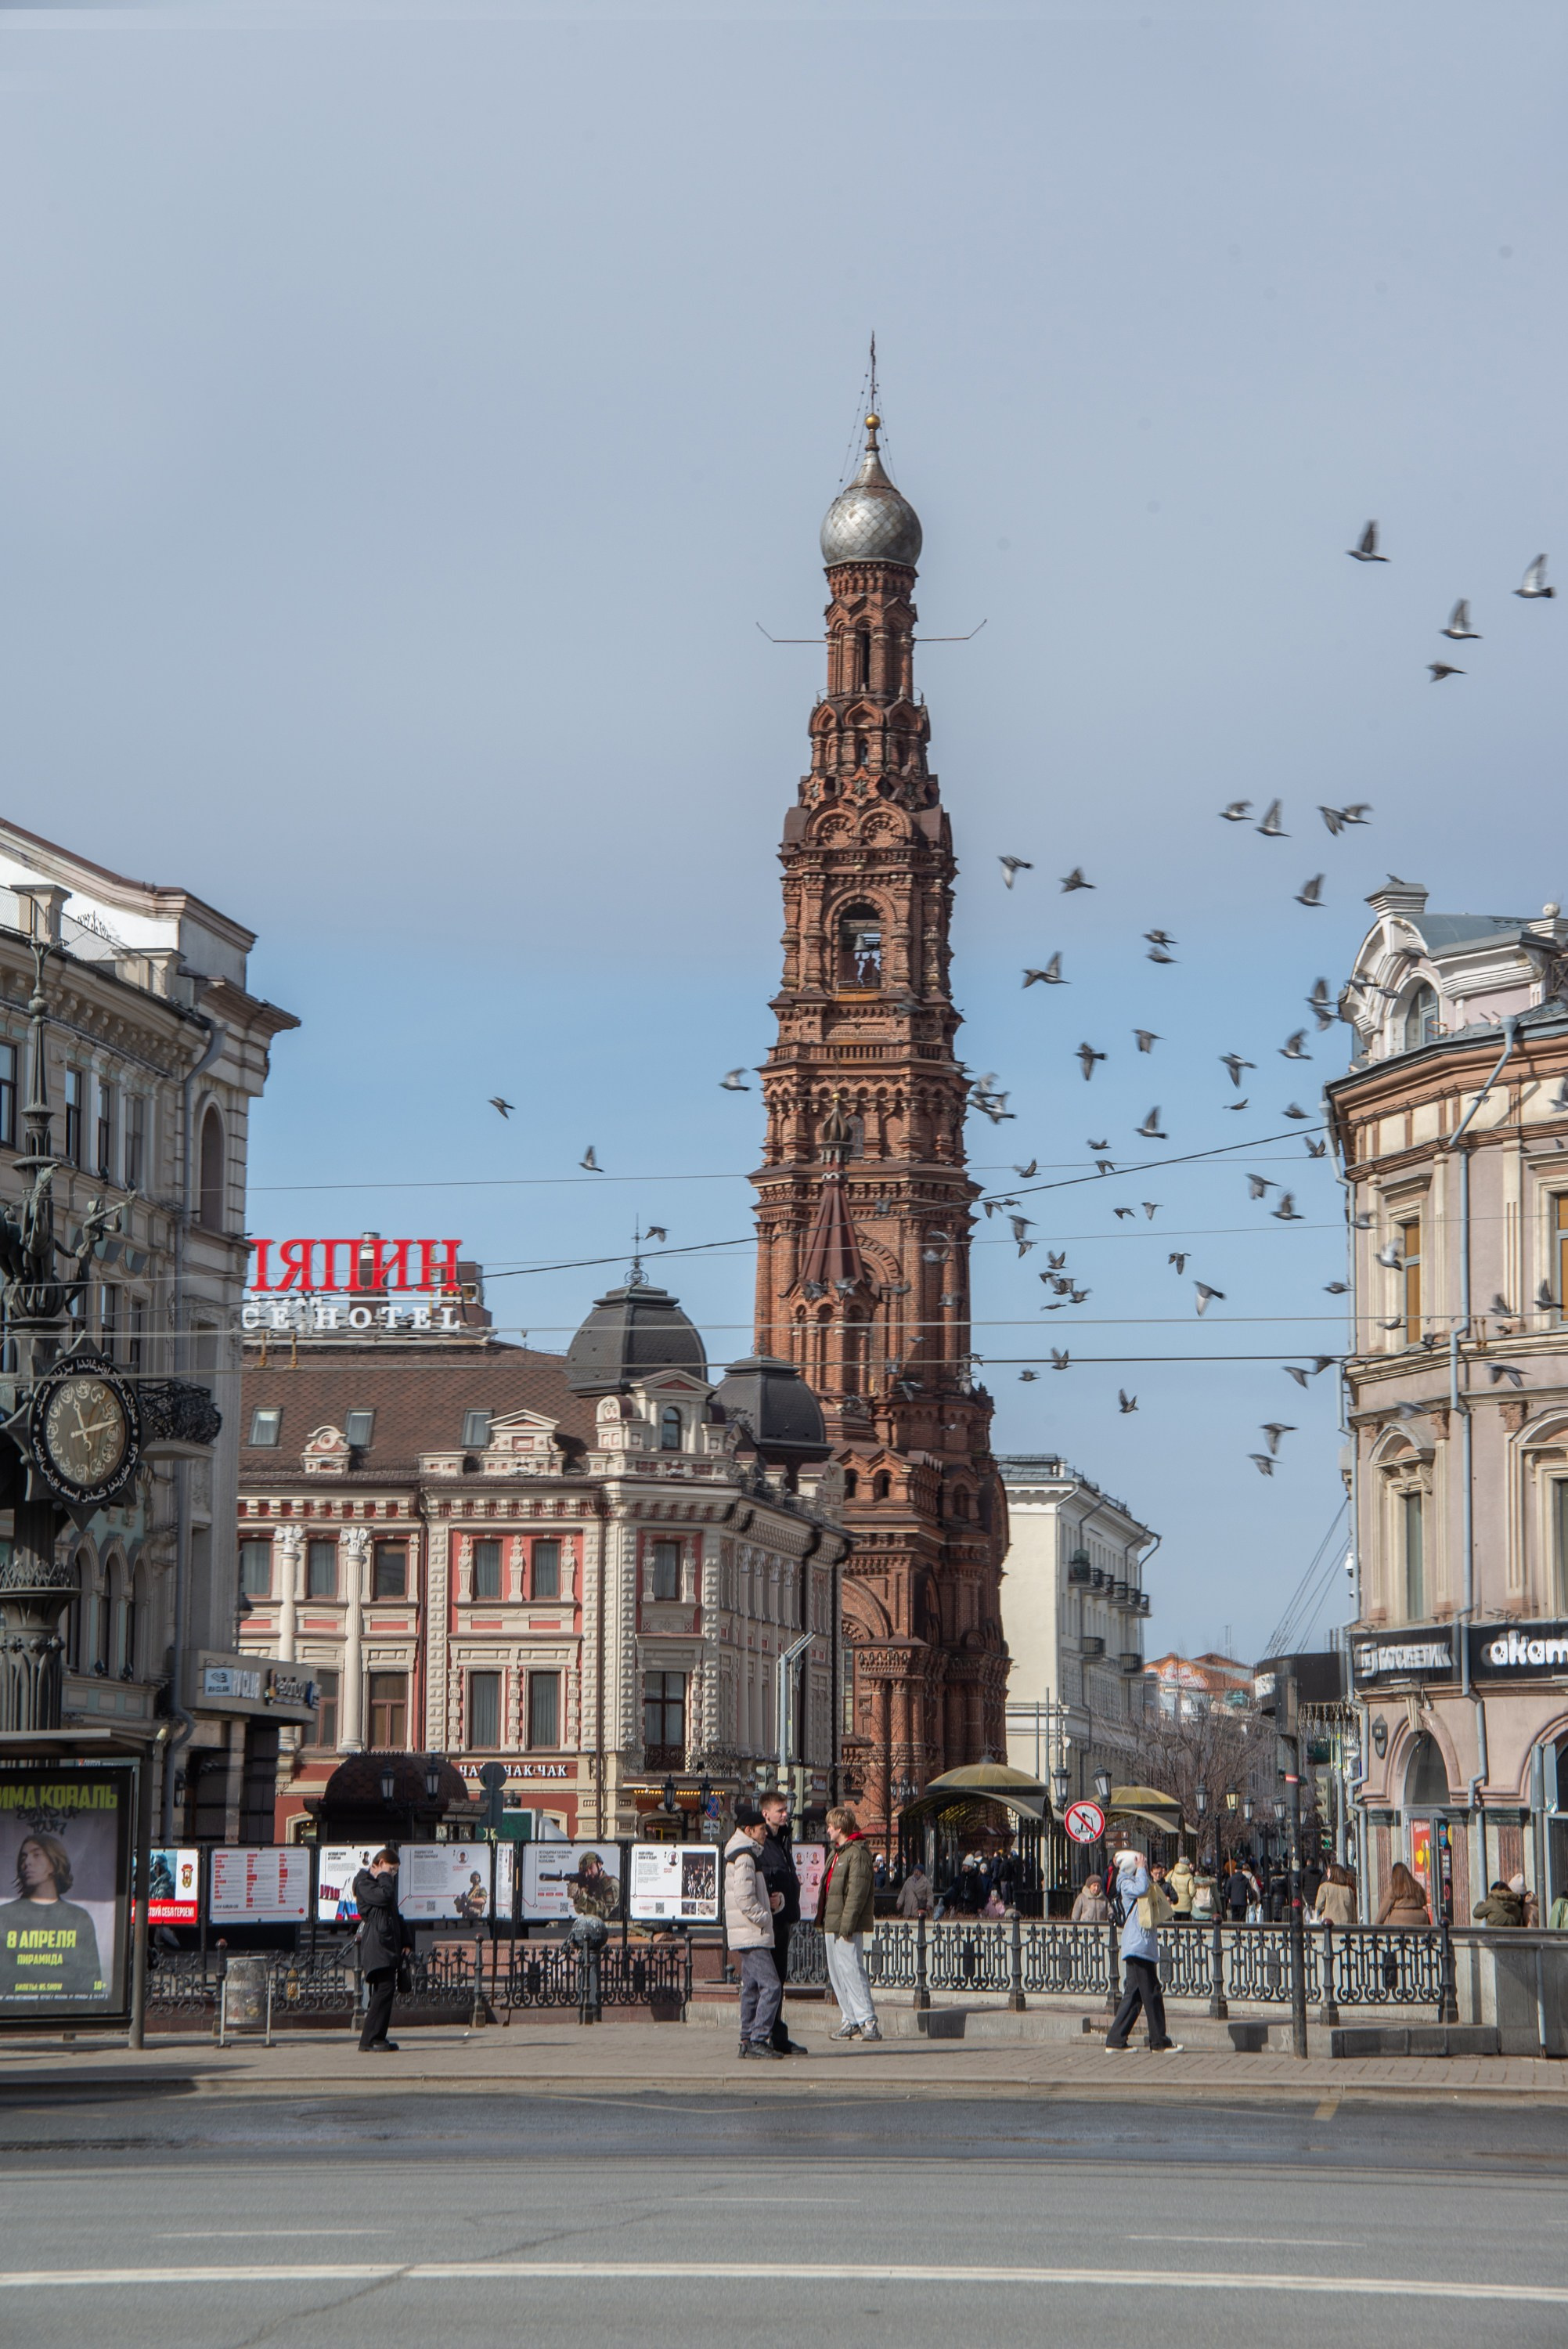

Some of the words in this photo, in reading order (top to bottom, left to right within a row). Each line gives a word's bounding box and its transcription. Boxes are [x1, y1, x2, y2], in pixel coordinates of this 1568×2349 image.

[251, 1294, 323, 1307] KAZAN
[315, 1307, 460, 1330] HOTEL
[40, 1785, 118, 1810] КОВАЛЬ
[161, 1907, 174, 1918] СЕБЯ
[6, 1929, 17, 1949] 8
[19, 1929, 77, 1949] АПРЕЛЯ
[16, 1953, 63, 1966] ПИРАМИДА
